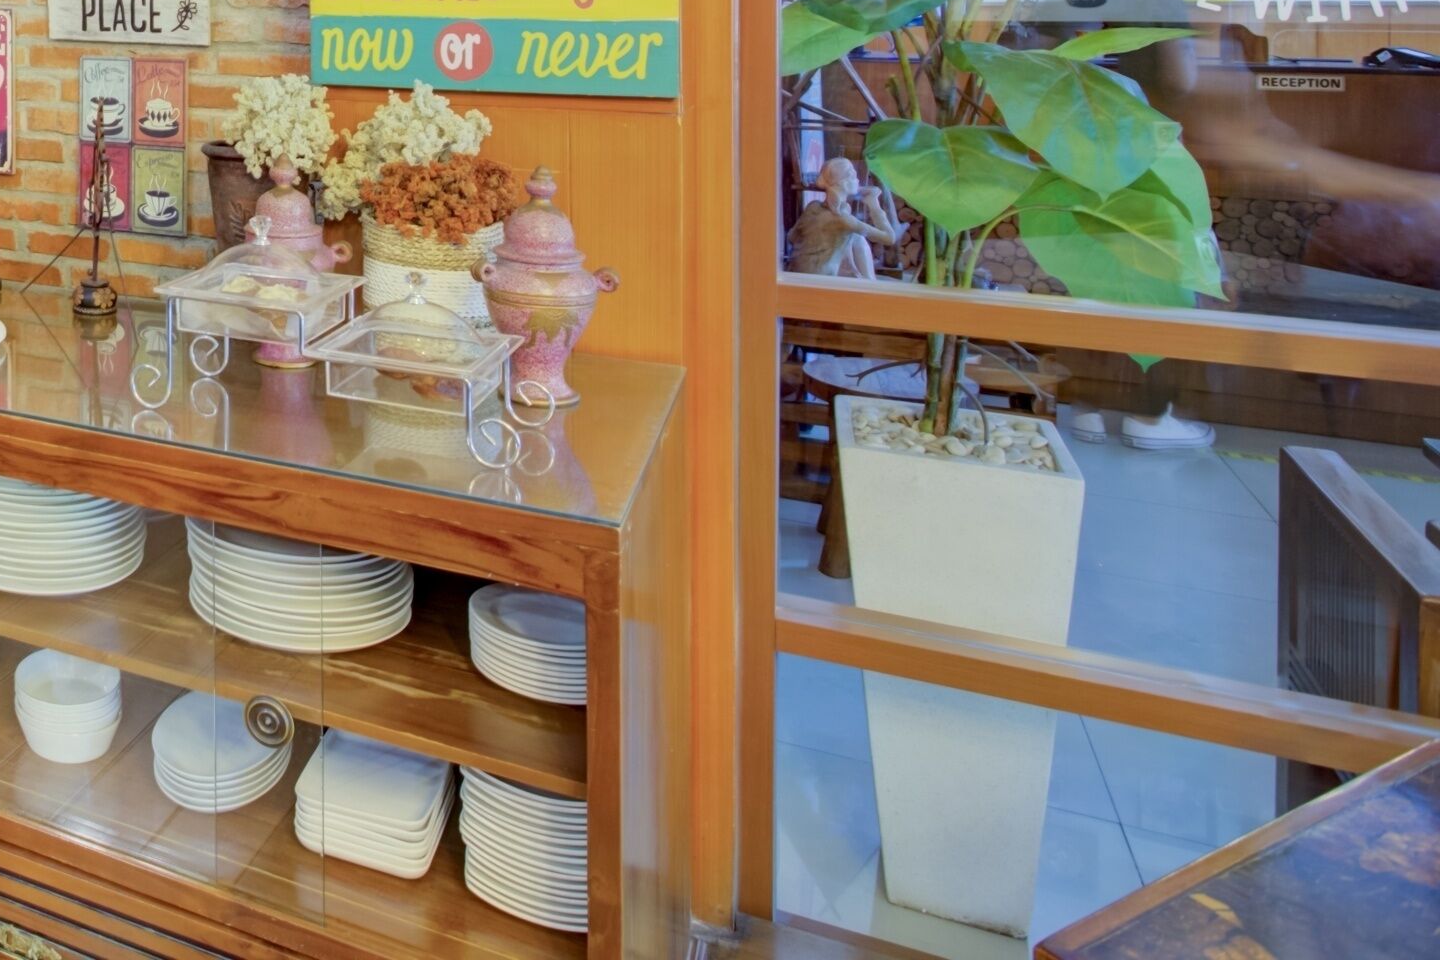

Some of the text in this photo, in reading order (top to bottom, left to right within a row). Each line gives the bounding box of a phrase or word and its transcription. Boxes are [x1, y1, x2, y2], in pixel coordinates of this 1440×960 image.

[321, 27, 663, 80] now or never
[1261, 76, 1341, 89] RECEPTION
